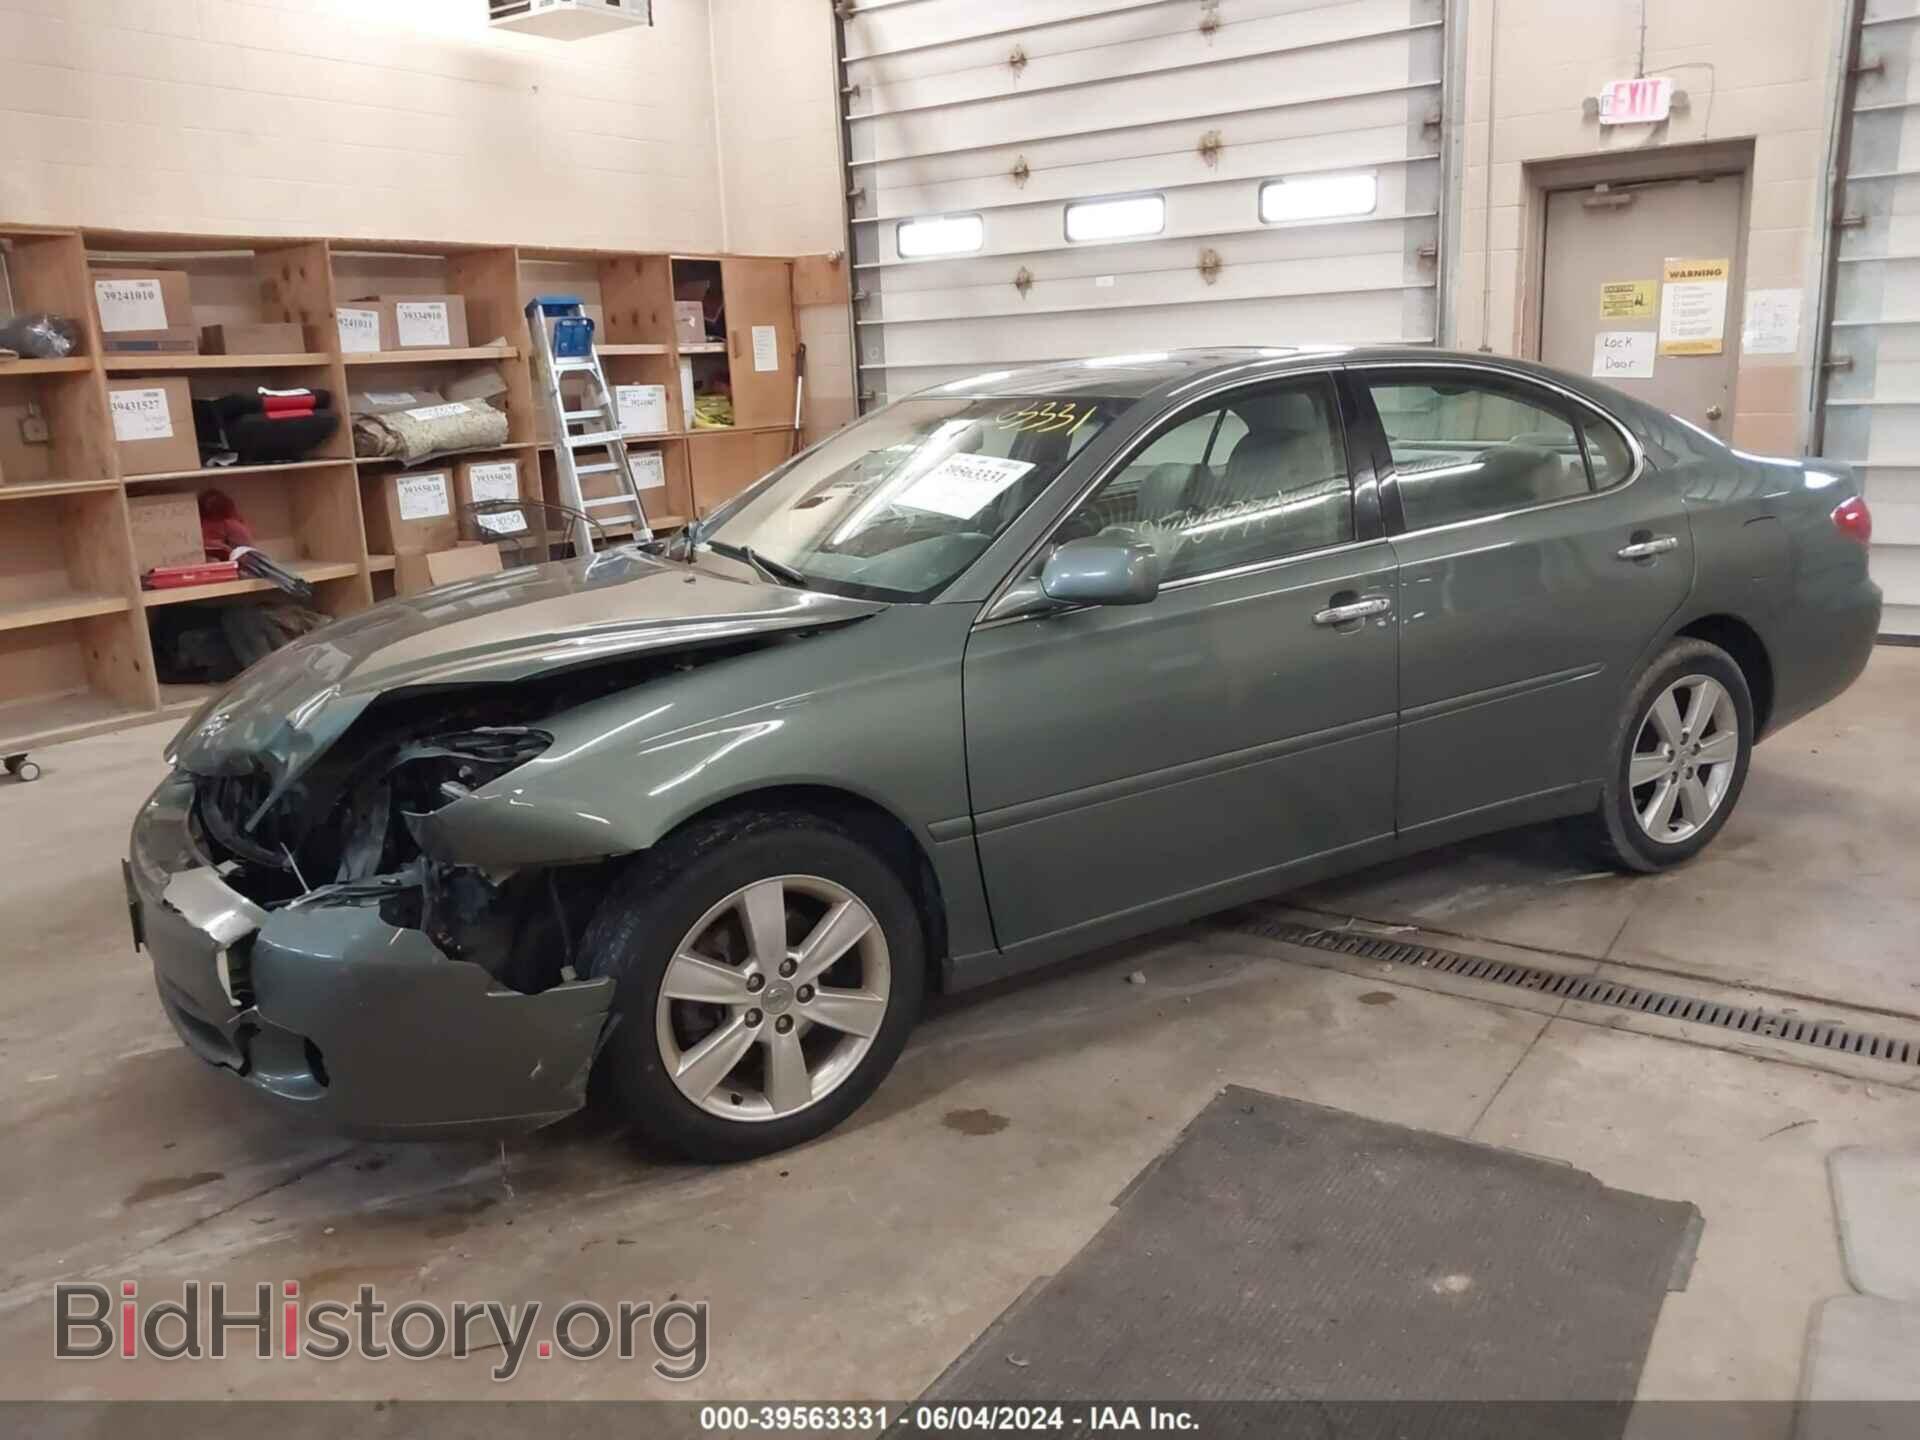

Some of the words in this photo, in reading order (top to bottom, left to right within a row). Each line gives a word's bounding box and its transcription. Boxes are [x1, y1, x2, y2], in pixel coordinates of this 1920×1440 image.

[1610, 80, 1661, 114] EXIT
[1669, 268, 1722, 279] WARNING
[104, 291, 155, 300] 39241010
[402, 311, 442, 320] 39334910
[1605, 355, 1637, 370] Door
[112, 400, 159, 410] 39431527
